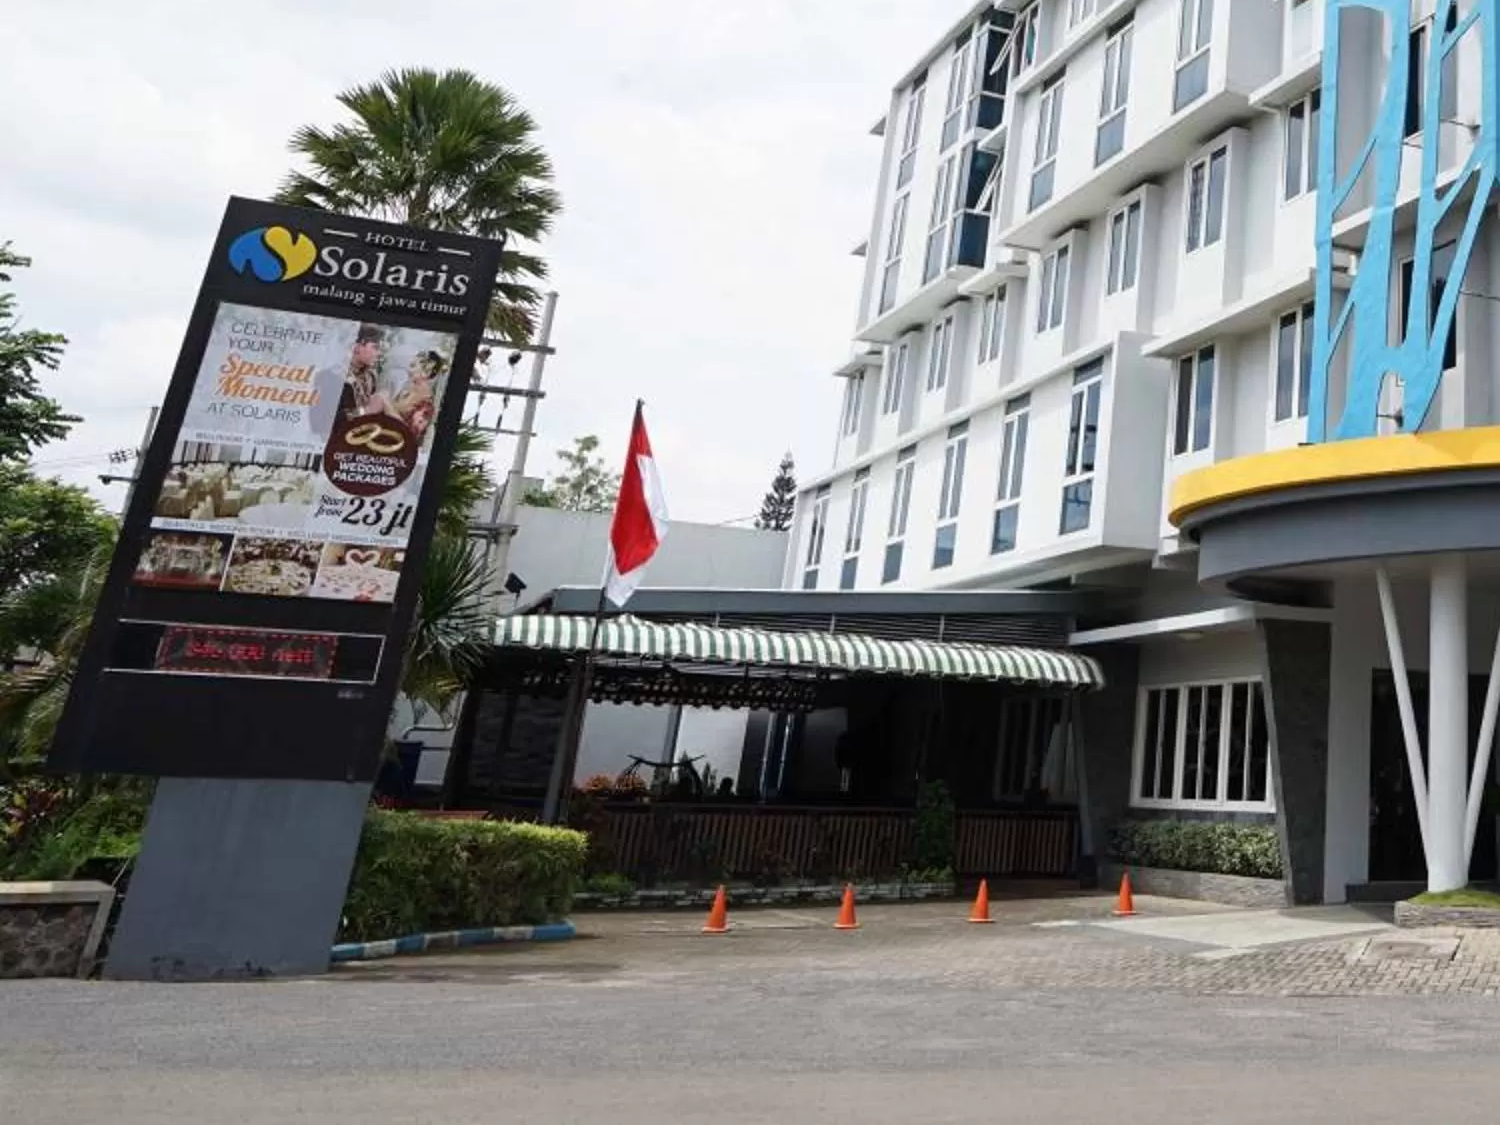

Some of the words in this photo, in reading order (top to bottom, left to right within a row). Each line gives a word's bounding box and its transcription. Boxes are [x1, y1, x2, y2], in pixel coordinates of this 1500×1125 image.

[365, 231, 430, 252] HOTEL
[314, 246, 470, 297] Solaris
[303, 284, 365, 305] malang
[377, 292, 417, 308] jawa
[421, 300, 468, 316] timur
[228, 337, 275, 353] YOUR
[231, 321, 325, 345] CELEBRATE
[219, 353, 316, 384] Special
[212, 375, 320, 407] Moment
[206, 401, 229, 414] AT
[231, 404, 303, 424] SOLARIS
[331, 469, 397, 486] PACKAGES
[339, 461, 395, 475] WEDDING
[341, 496, 387, 526] 23
